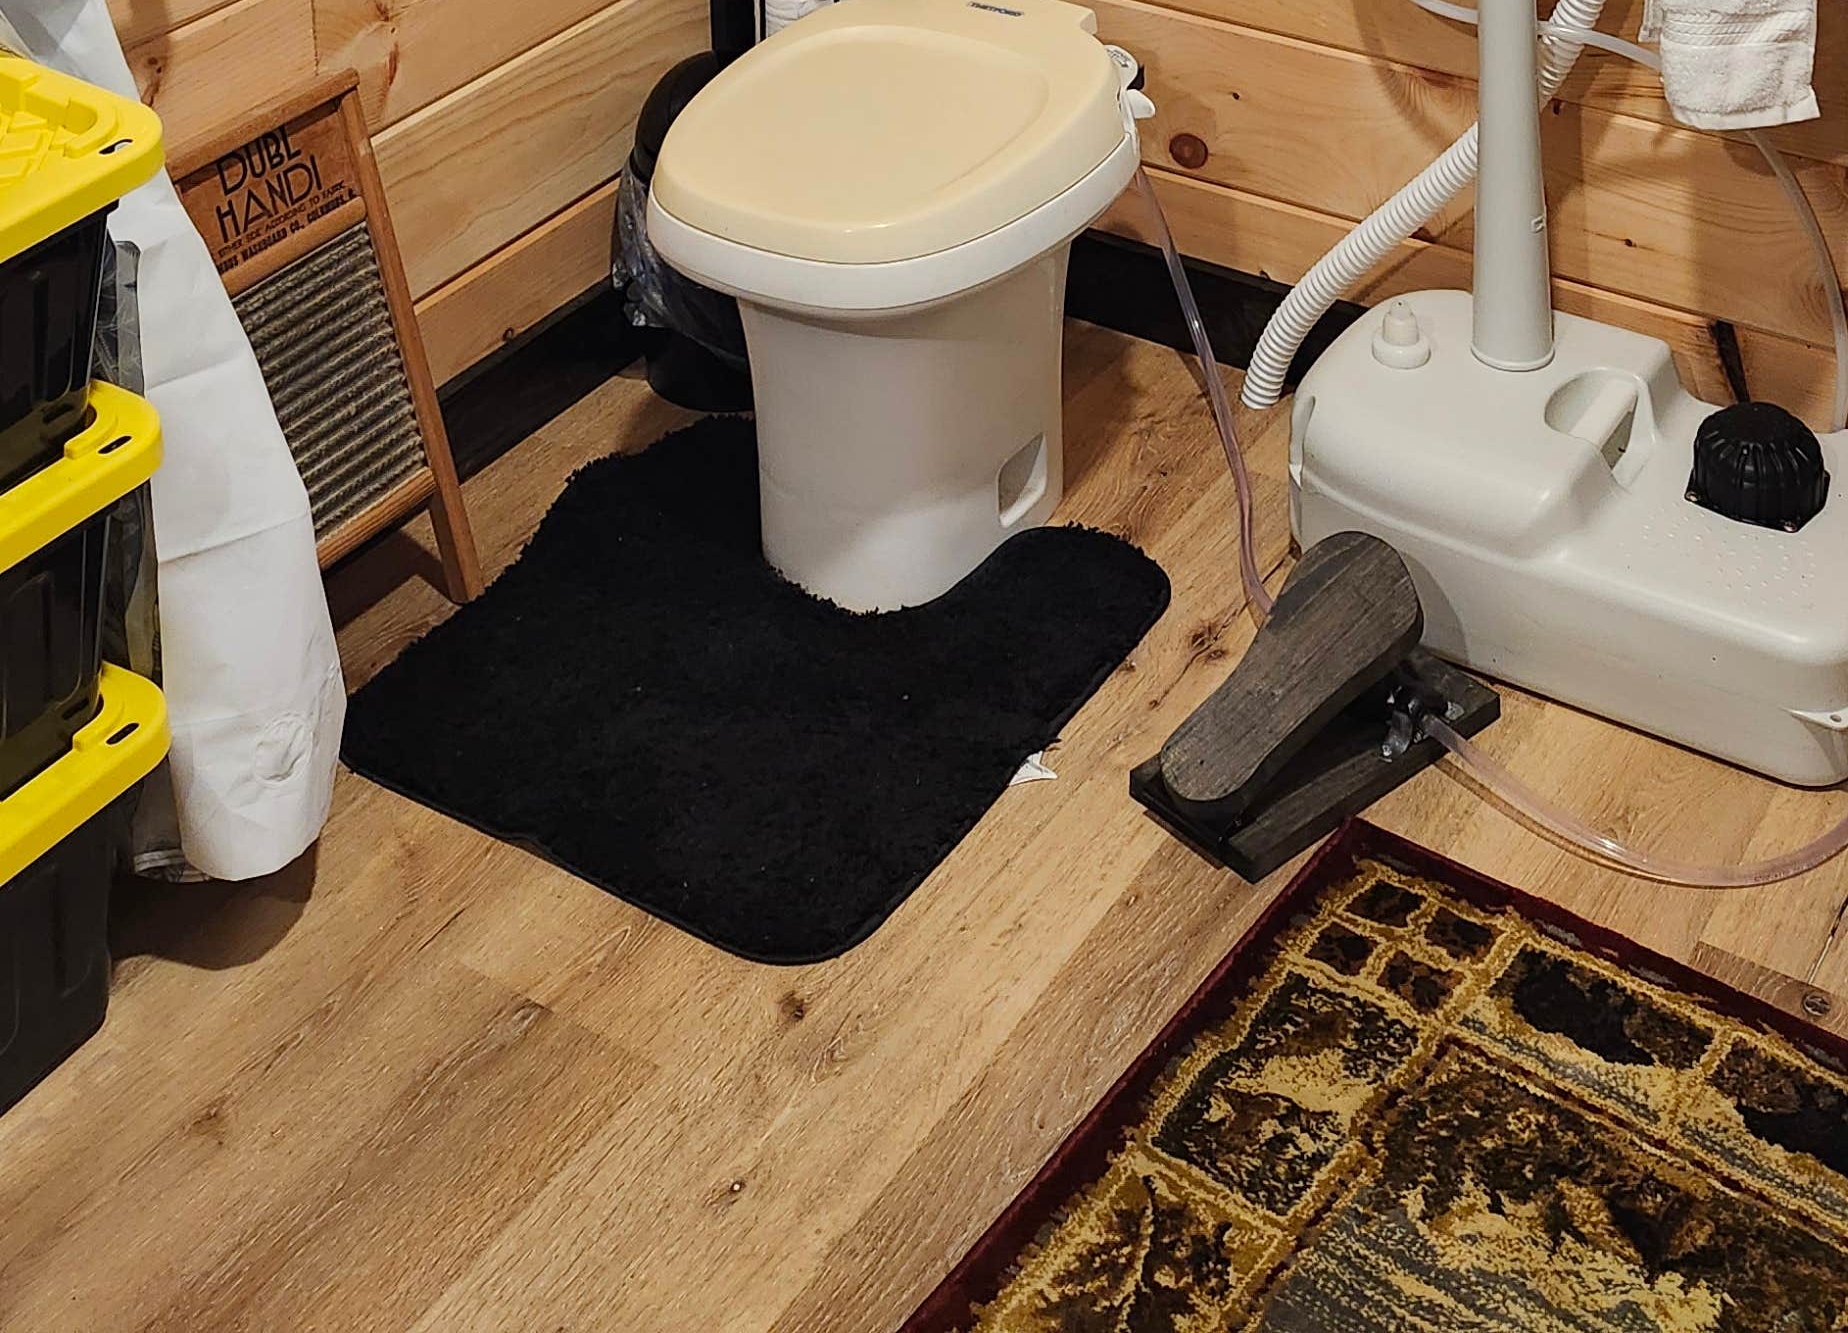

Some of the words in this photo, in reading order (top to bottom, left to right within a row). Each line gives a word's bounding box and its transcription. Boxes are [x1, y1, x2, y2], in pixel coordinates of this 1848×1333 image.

[216, 124, 302, 196] DUBL
[215, 154, 323, 244] HANDI
[308, 195, 320, 207] TO
